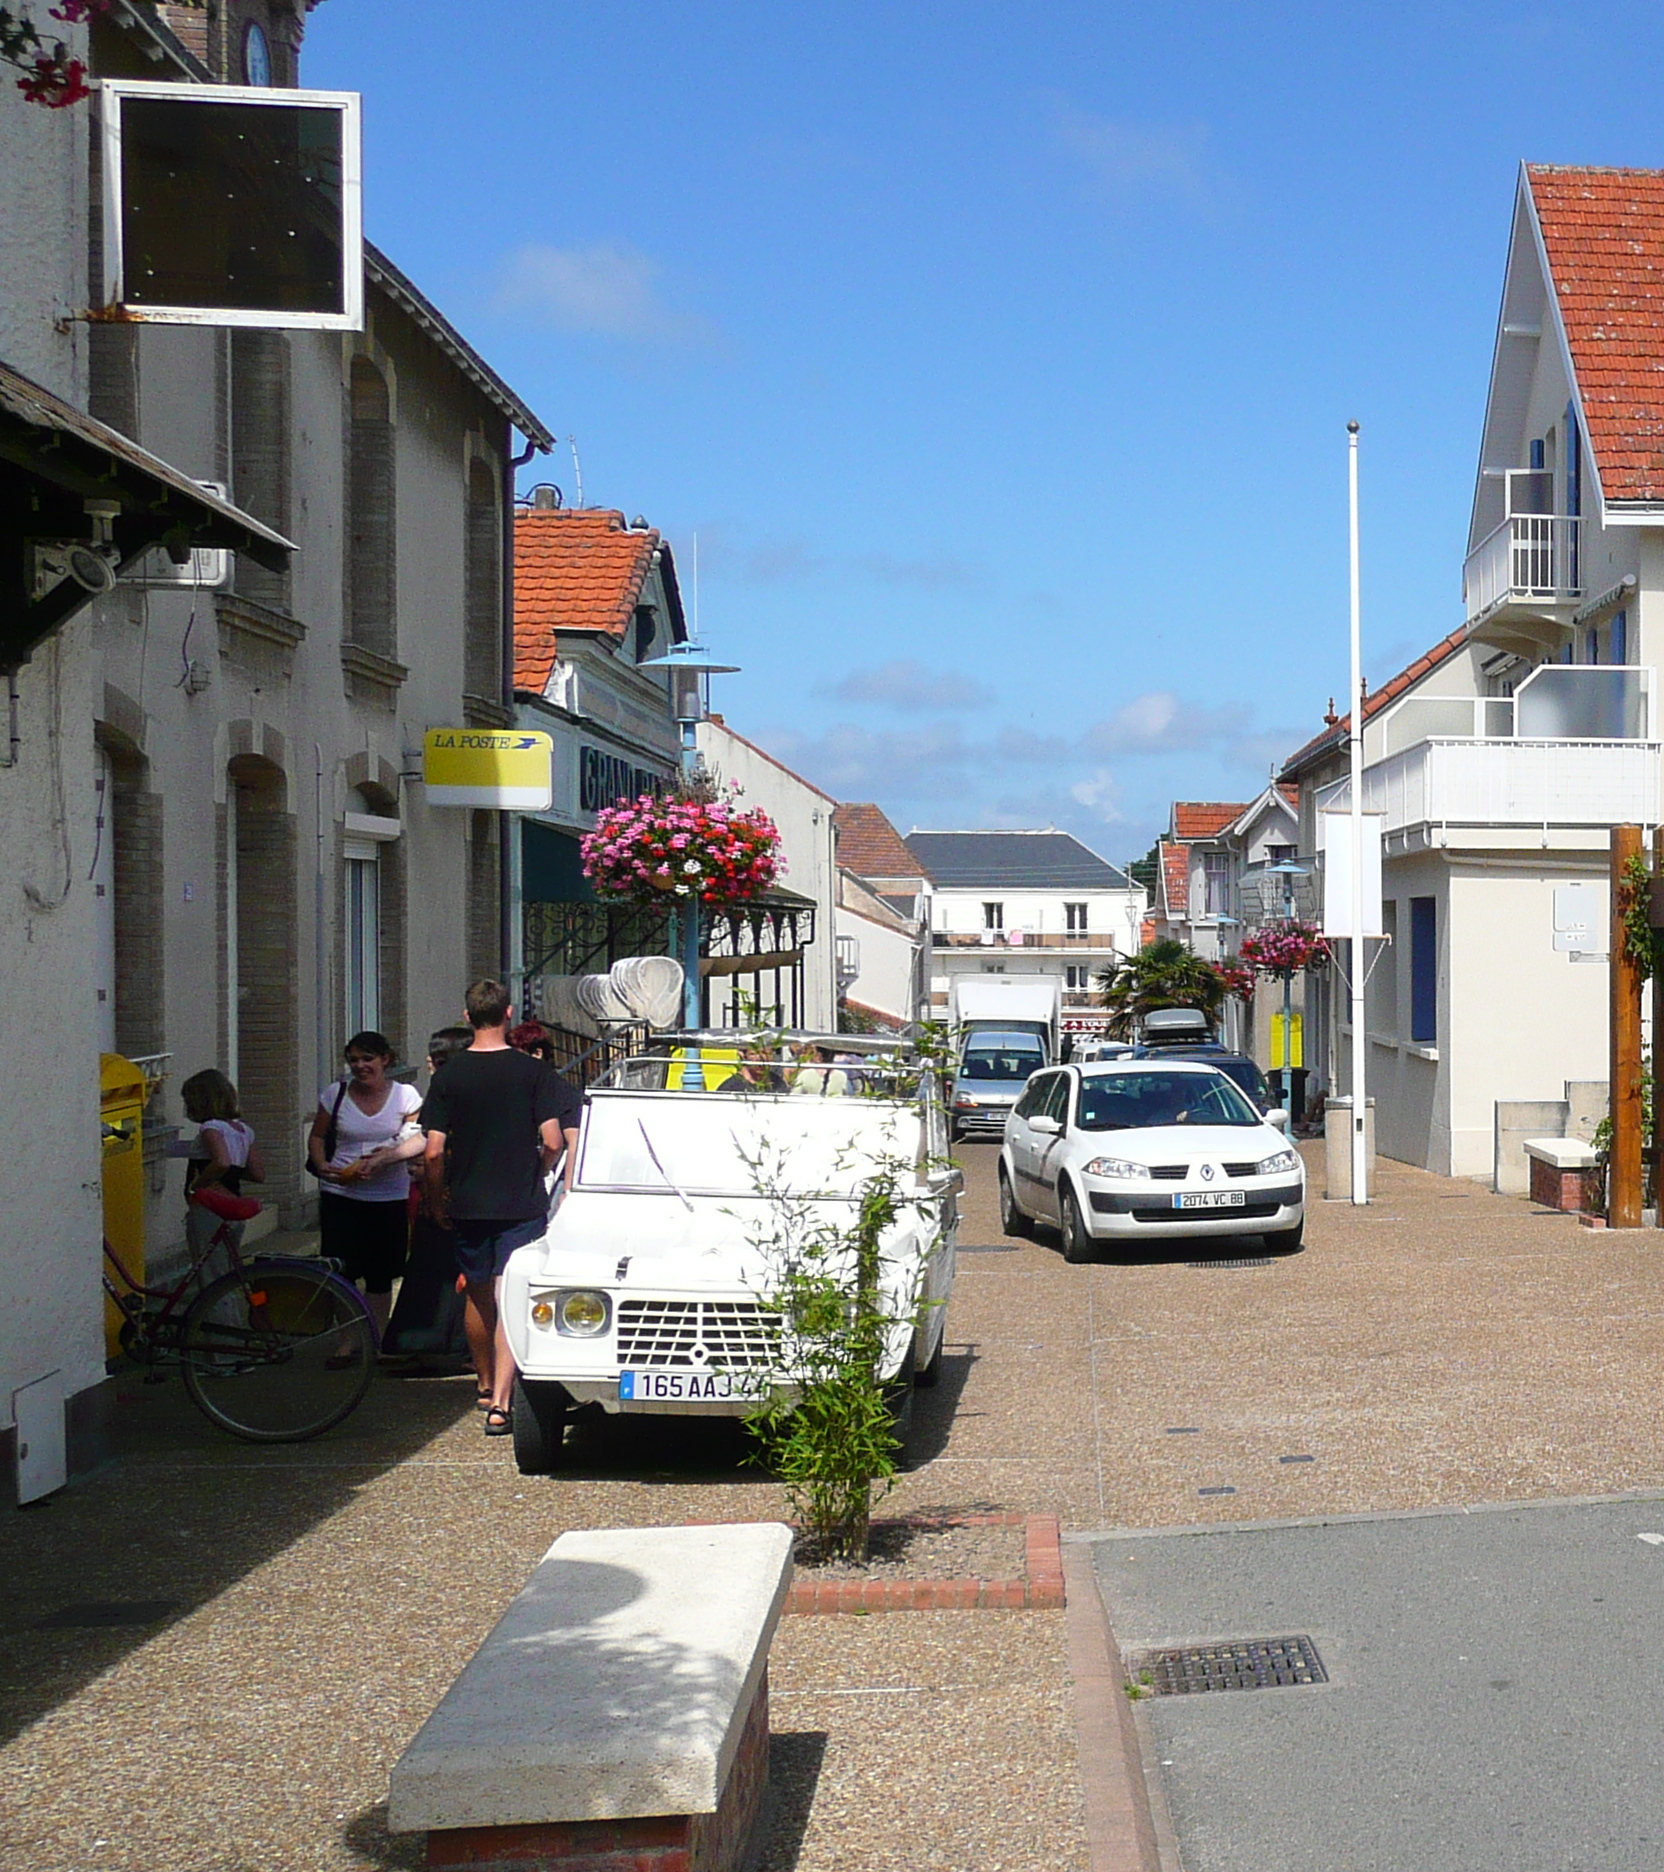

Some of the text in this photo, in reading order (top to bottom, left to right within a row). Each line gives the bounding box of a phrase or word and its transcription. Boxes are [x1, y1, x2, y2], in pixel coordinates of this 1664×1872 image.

[433, 734, 511, 749] LA POSTE
[1182, 1194, 1209, 1207] 2074
[642, 1374, 683, 1398] 165
[688, 1375, 732, 1398] AAJ
